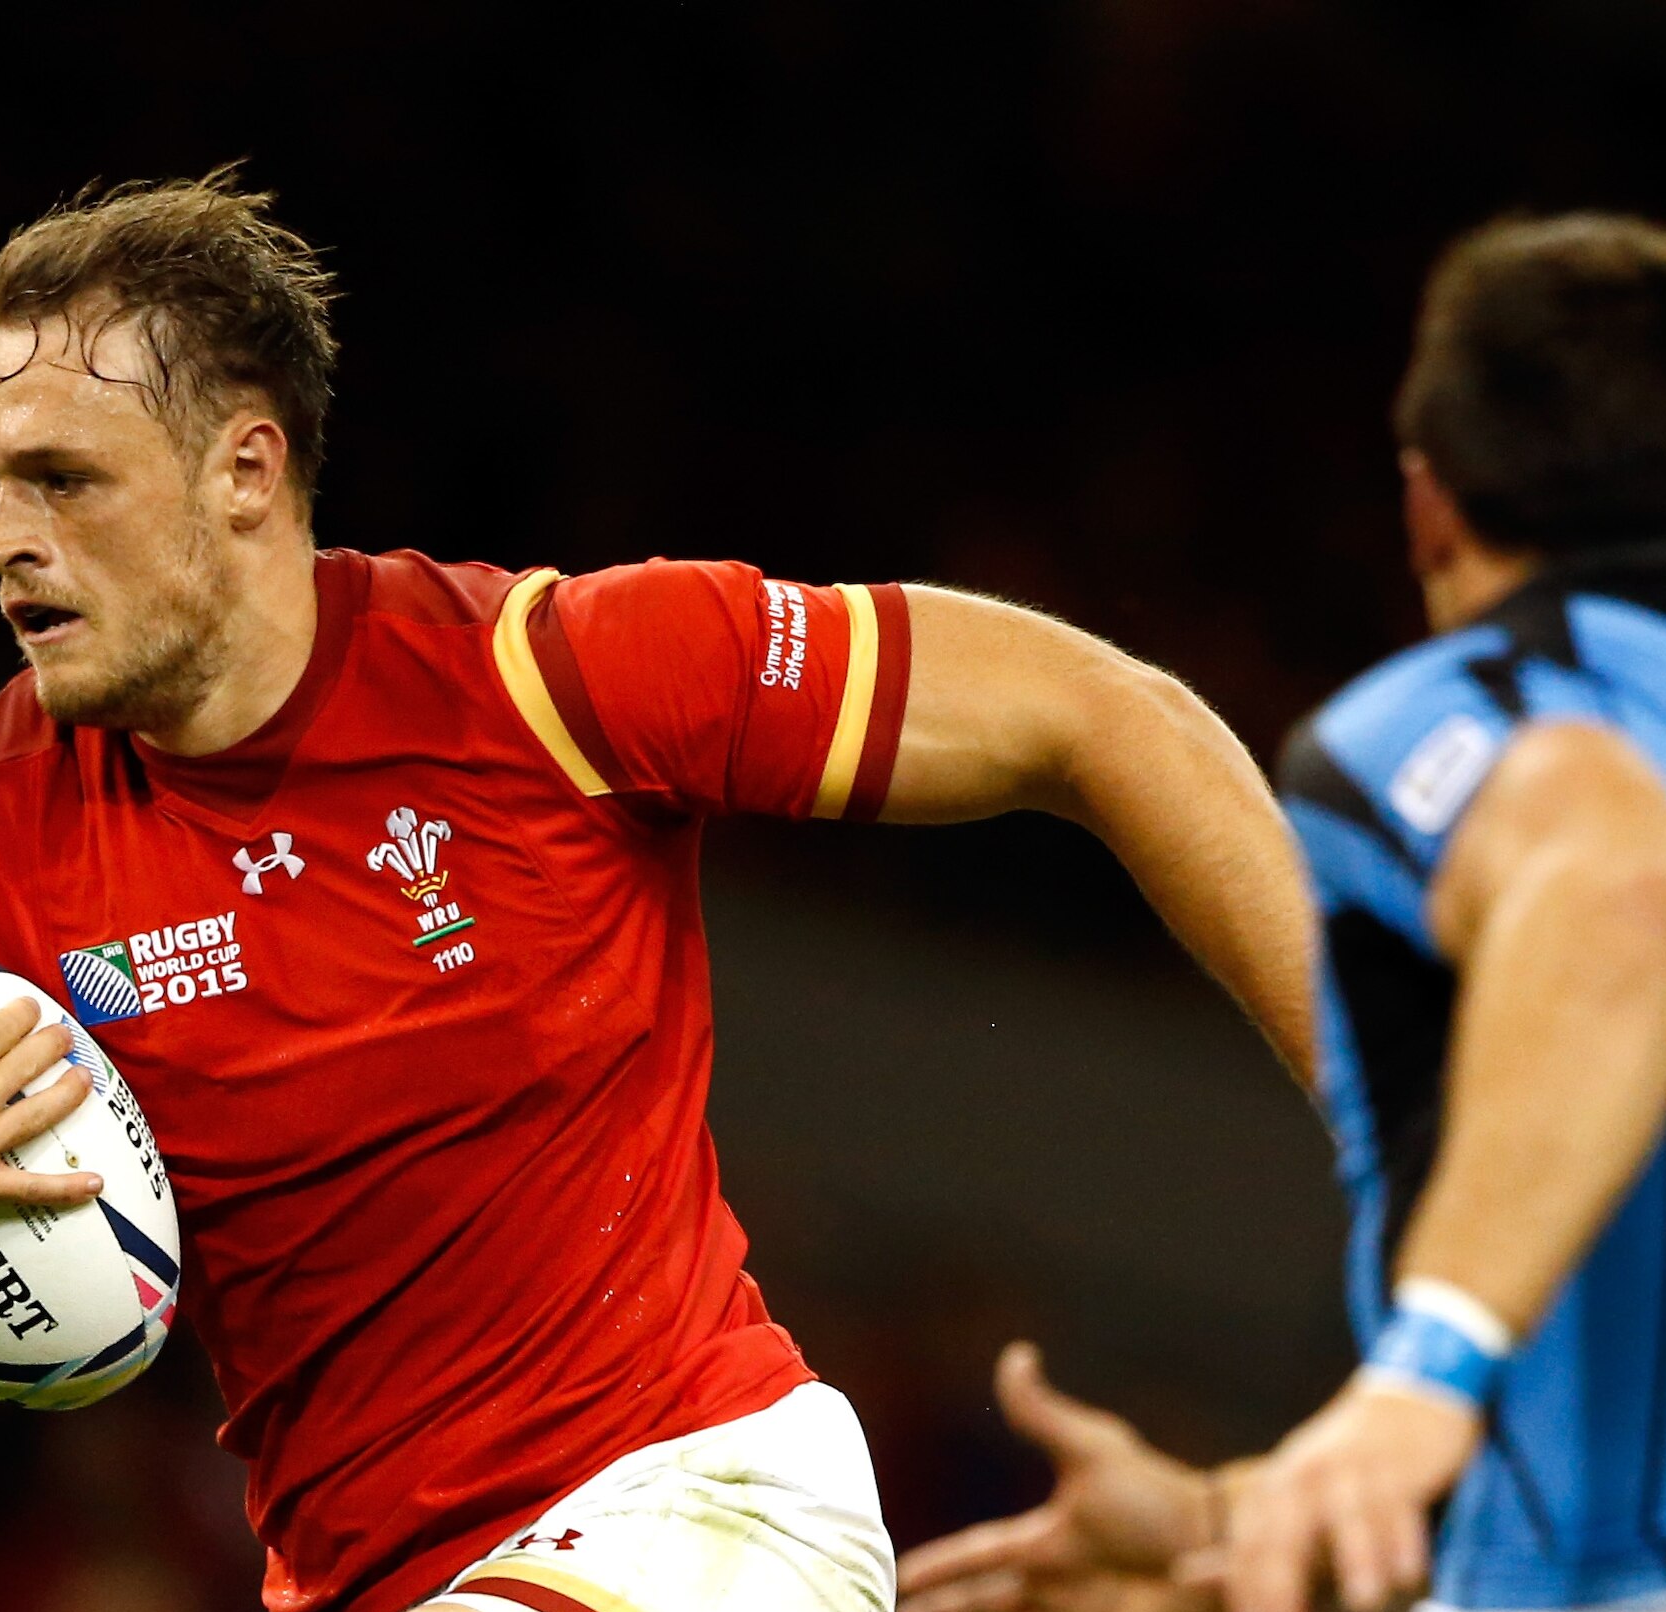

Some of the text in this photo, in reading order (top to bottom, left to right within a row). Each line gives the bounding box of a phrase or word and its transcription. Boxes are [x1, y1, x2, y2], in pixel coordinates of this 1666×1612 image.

[770, 619, 784, 630] v
[760, 632, 784, 687] Cymru
[128, 910, 236, 965] RUGBY
[416, 901, 461, 933] WRU
[136, 943, 242, 983] WORLD CUP
[432, 941, 475, 974] 1110
[139, 961, 248, 1014] 2015
[108, 1092, 162, 1201] 2015
